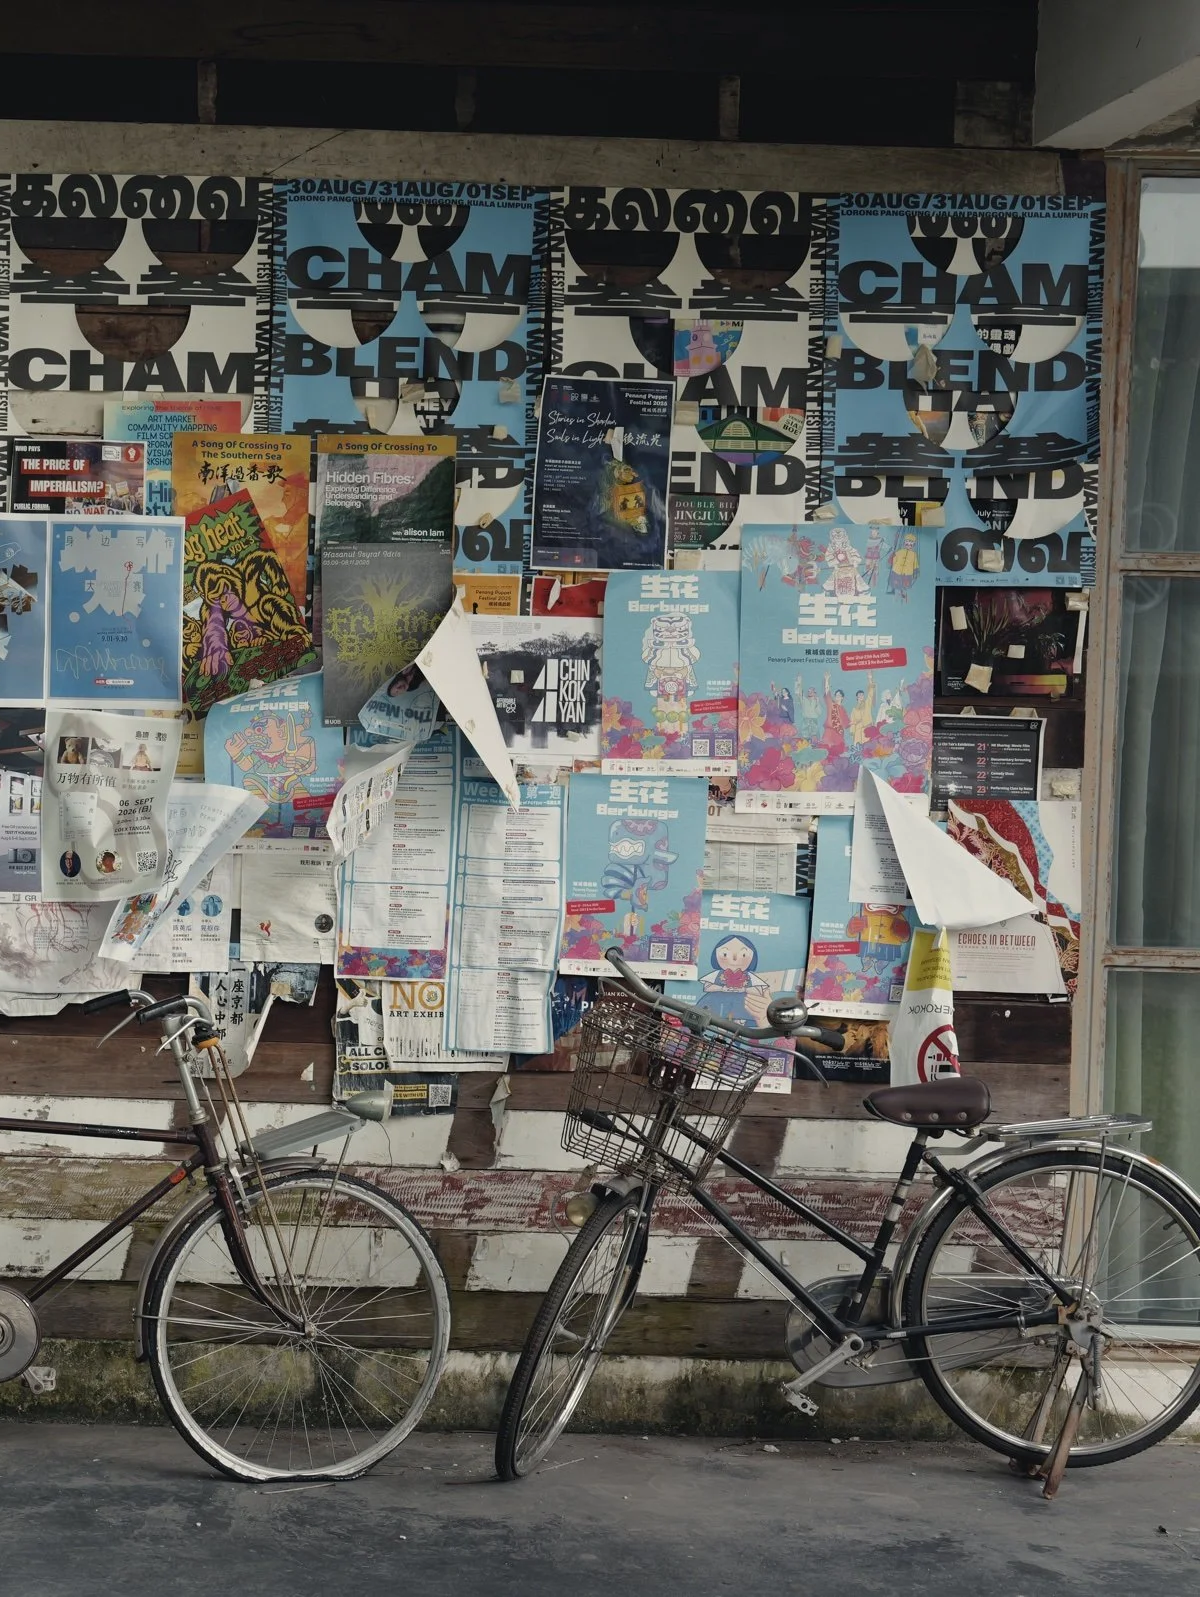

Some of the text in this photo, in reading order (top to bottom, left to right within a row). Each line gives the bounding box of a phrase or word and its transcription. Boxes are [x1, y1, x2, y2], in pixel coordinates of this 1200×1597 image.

[288, 179, 535, 200] 30AUG/31AUG/01SEP
[840, 192, 1092, 211] 30AUG/31AUG/01SEP
[258, 188, 273, 260] WANT
[286, 245, 532, 297] CHAM
[837, 260, 1089, 306] CHAM
[284, 334, 528, 381] BLEND
[8, 348, 257, 391] CHAM
[147, 415, 197, 423] ART MARKET
[127, 423, 217, 432] COMMUNITY MAPPING
[137, 432, 155, 440] FILM
[200, 440, 292, 451] Song Crossing To
[345, 443, 438, 452] Song Crossing To
[201, 451, 282, 460] The Southern Sea
[22, 459, 85, 471] THE PRICE OF
[326, 472, 415, 484] Hidden Fibres:
[30, 480, 104, 493] IMPERIALISM?
[325, 486, 359, 494] Exploring
[325, 492, 377, 501] Understanding
[325, 500, 361, 508] Belonging
[83, 507, 105, 515] WAR
[975, 510, 992, 518] July
[204, 513, 246, 549] heat
[404, 528, 444, 538] alison lam
[641, 575, 699, 599] 生花
[628, 601, 710, 613] Berbunga
[798, 593, 877, 628] 生花
[781, 628, 893, 646] Berbunga
[559, 659, 590, 681] CHIN
[559, 680, 586, 702] KOK
[230, 700, 311, 713] Berbunga
[559, 701, 586, 723] YAN
[977, 743, 986, 751] 21
[977, 757, 986, 765] 22
[56, 772, 117, 788] 万物有所值
[977, 771, 986, 779] 22
[526, 787, 562, 799] 第一週
[609, 778, 669, 804] 生花
[977, 785, 986, 793] 23
[135, 797, 154, 806] SEPT
[596, 803, 679, 819] Berbunga
[710, 894, 771, 920] 生花
[700, 918, 780, 936] Berbunga
[958, 933, 1036, 947] ECHOES IN BETWEEN
[230, 968, 246, 1025] 一座京都
[389, 982, 445, 1010] NO
[349, 1048, 370, 1056] ALL
